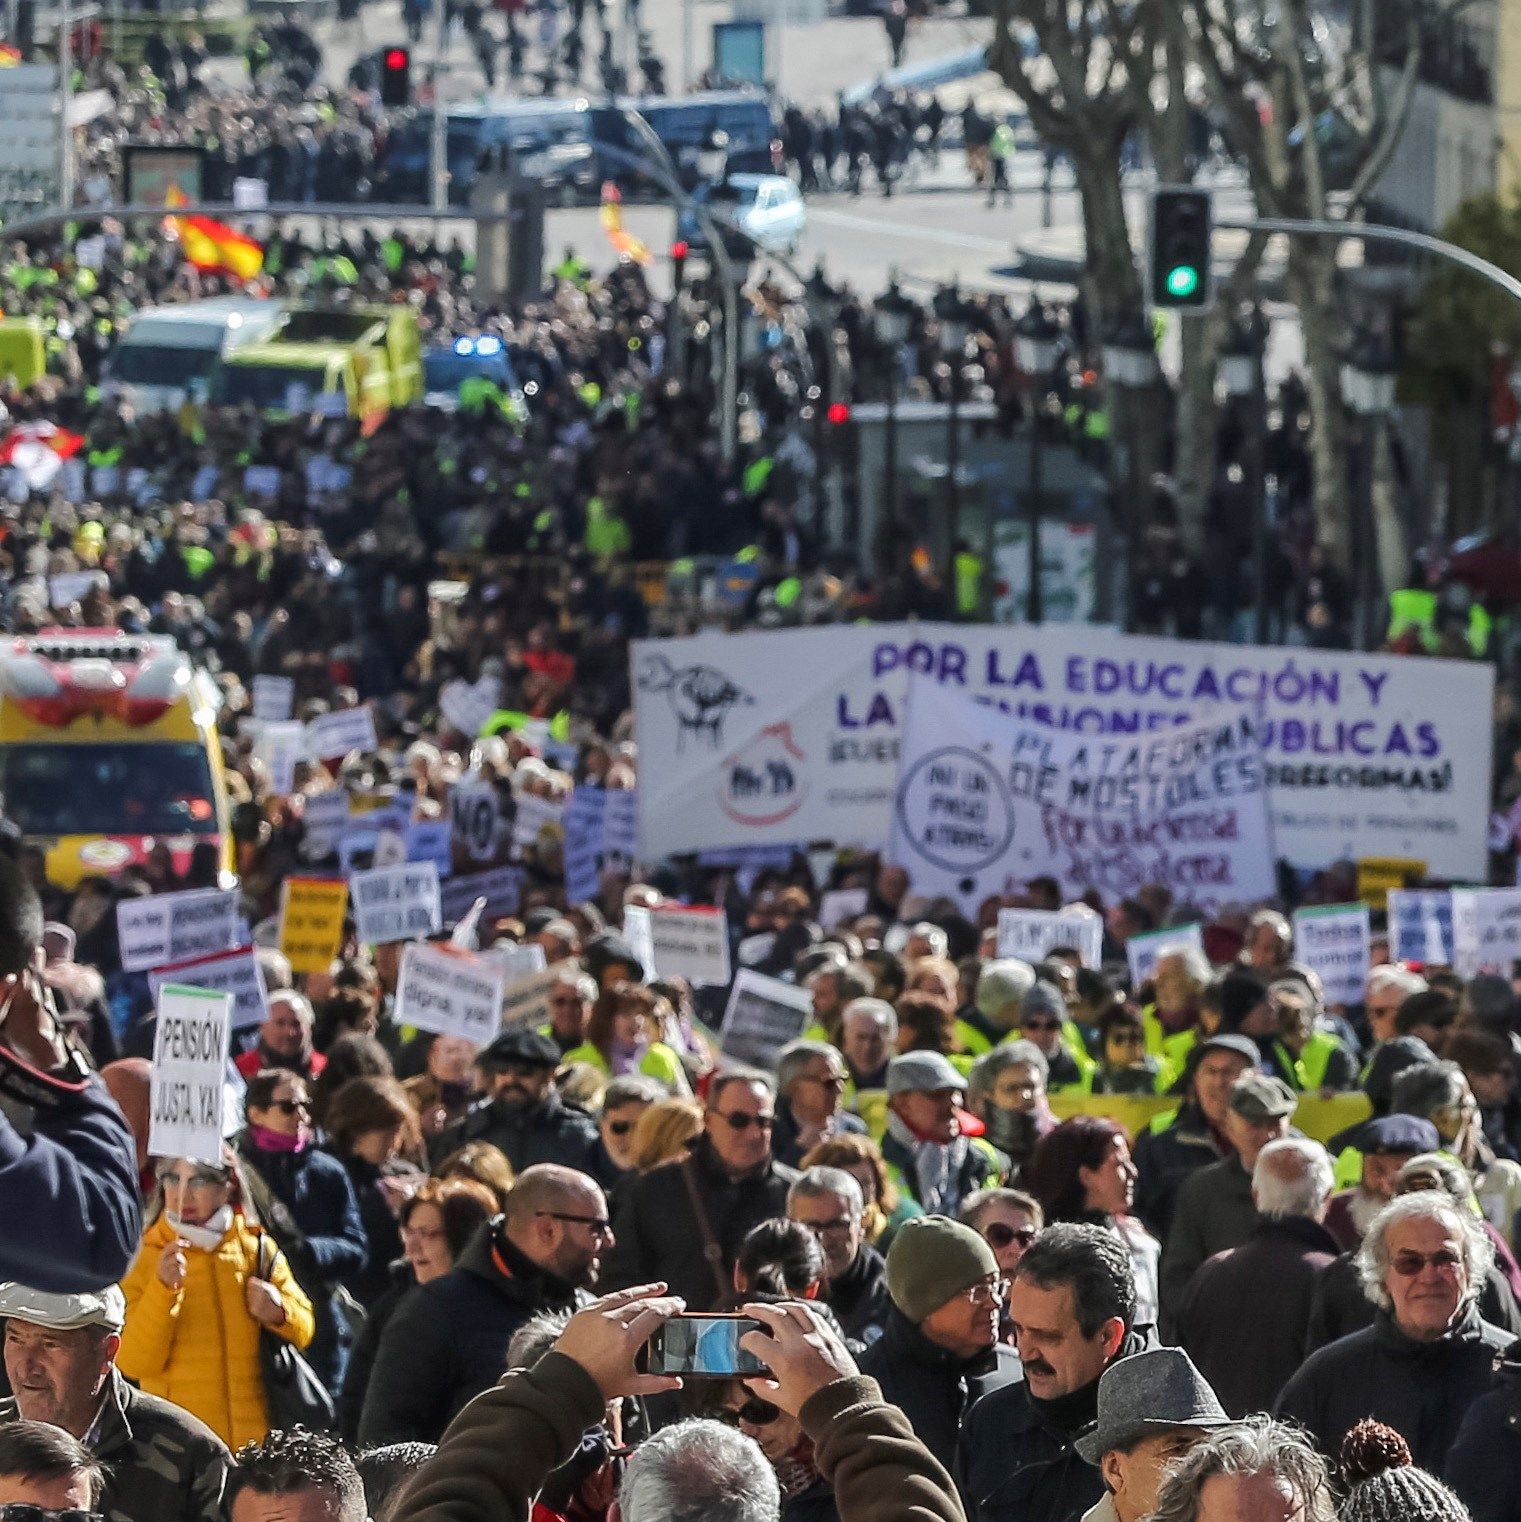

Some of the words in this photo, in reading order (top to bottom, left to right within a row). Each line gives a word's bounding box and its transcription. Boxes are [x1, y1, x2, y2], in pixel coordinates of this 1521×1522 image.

[873, 641, 967, 685] POR
[988, 648, 1044, 690] LA
[1065, 655, 1341, 705] EDUCACIÓN
[1359, 670, 1388, 706] Y
[838, 691, 907, 729] LA
